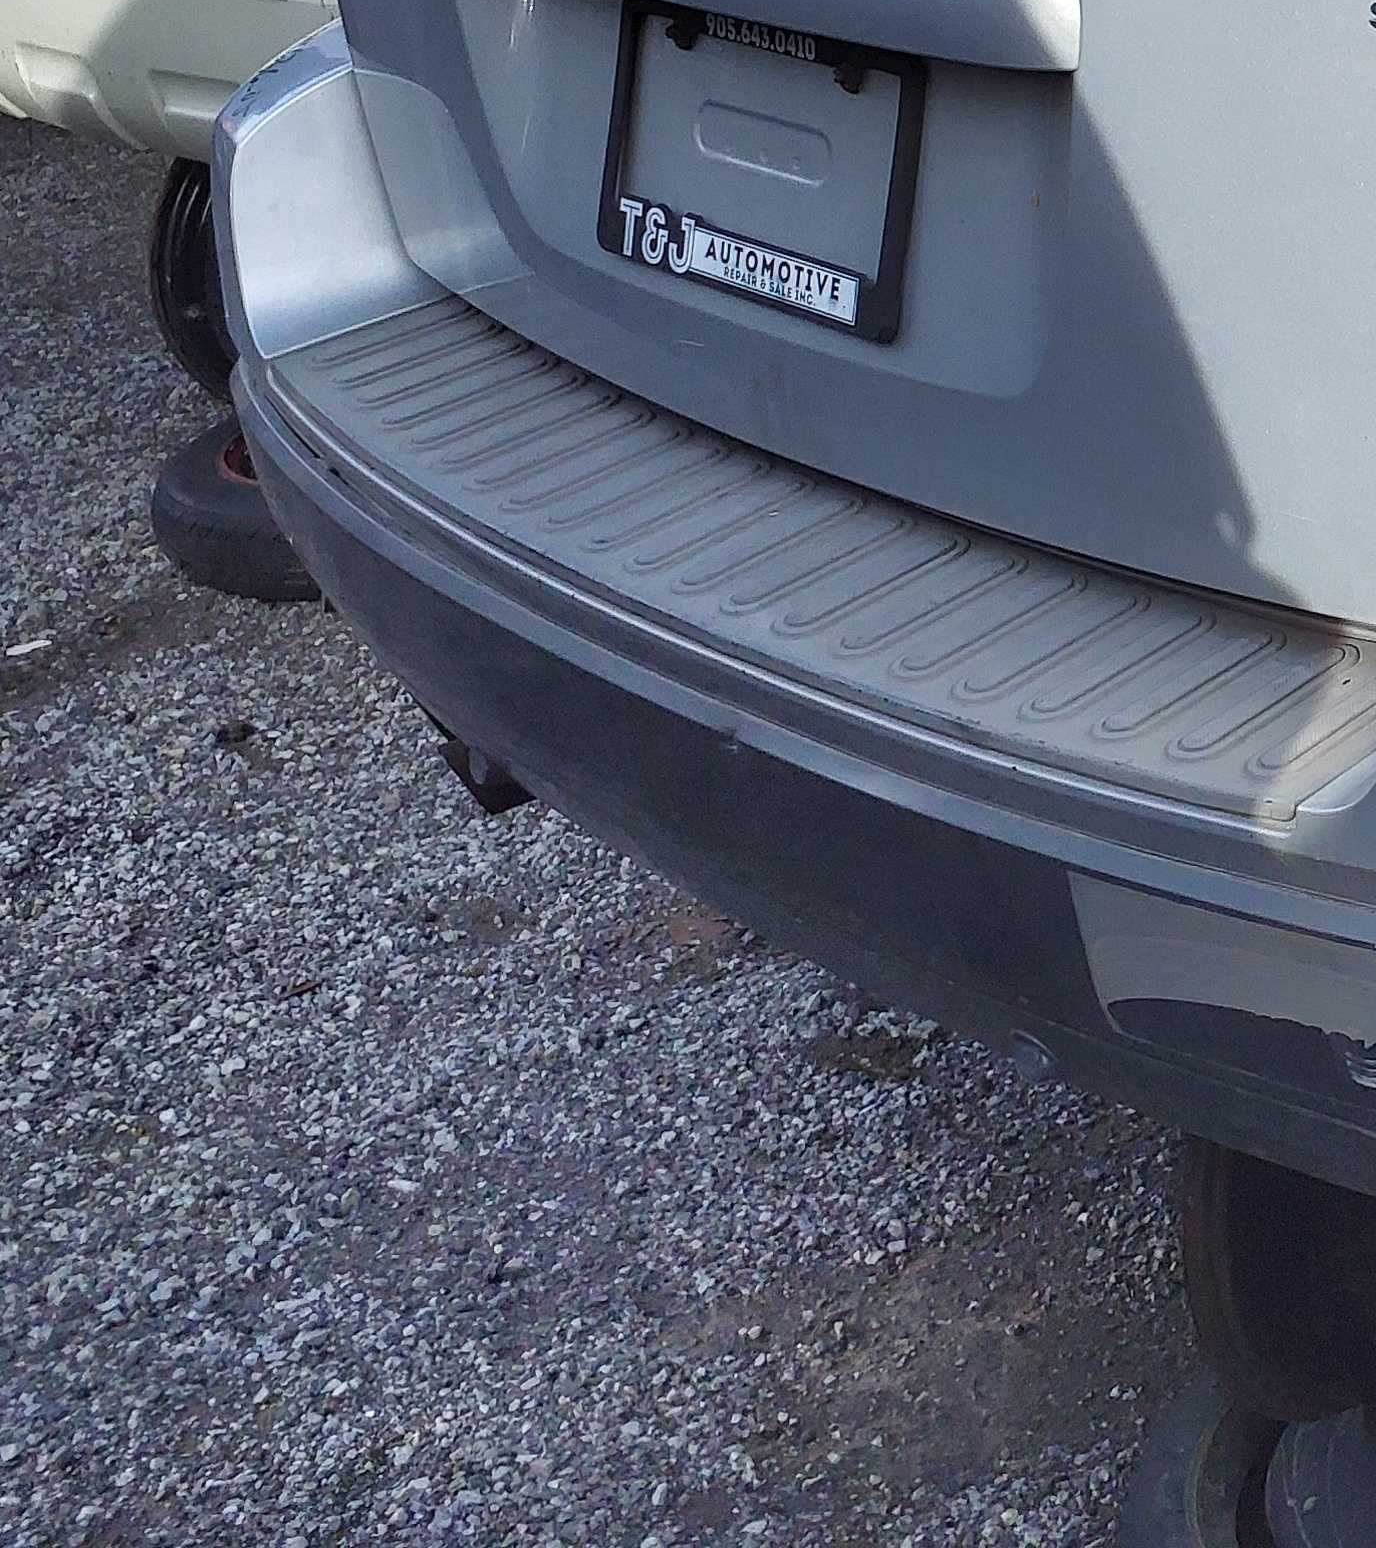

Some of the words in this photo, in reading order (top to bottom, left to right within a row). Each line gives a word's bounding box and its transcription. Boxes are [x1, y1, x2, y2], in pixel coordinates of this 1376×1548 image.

[705, 13, 817, 61] 905.643.0410
[619, 197, 696, 276] T&J
[704, 237, 841, 302] AUTOMOTIVE
[723, 266, 758, 286] REPAIR
[769, 281, 793, 299] SALE
[793, 290, 817, 307] INC.
